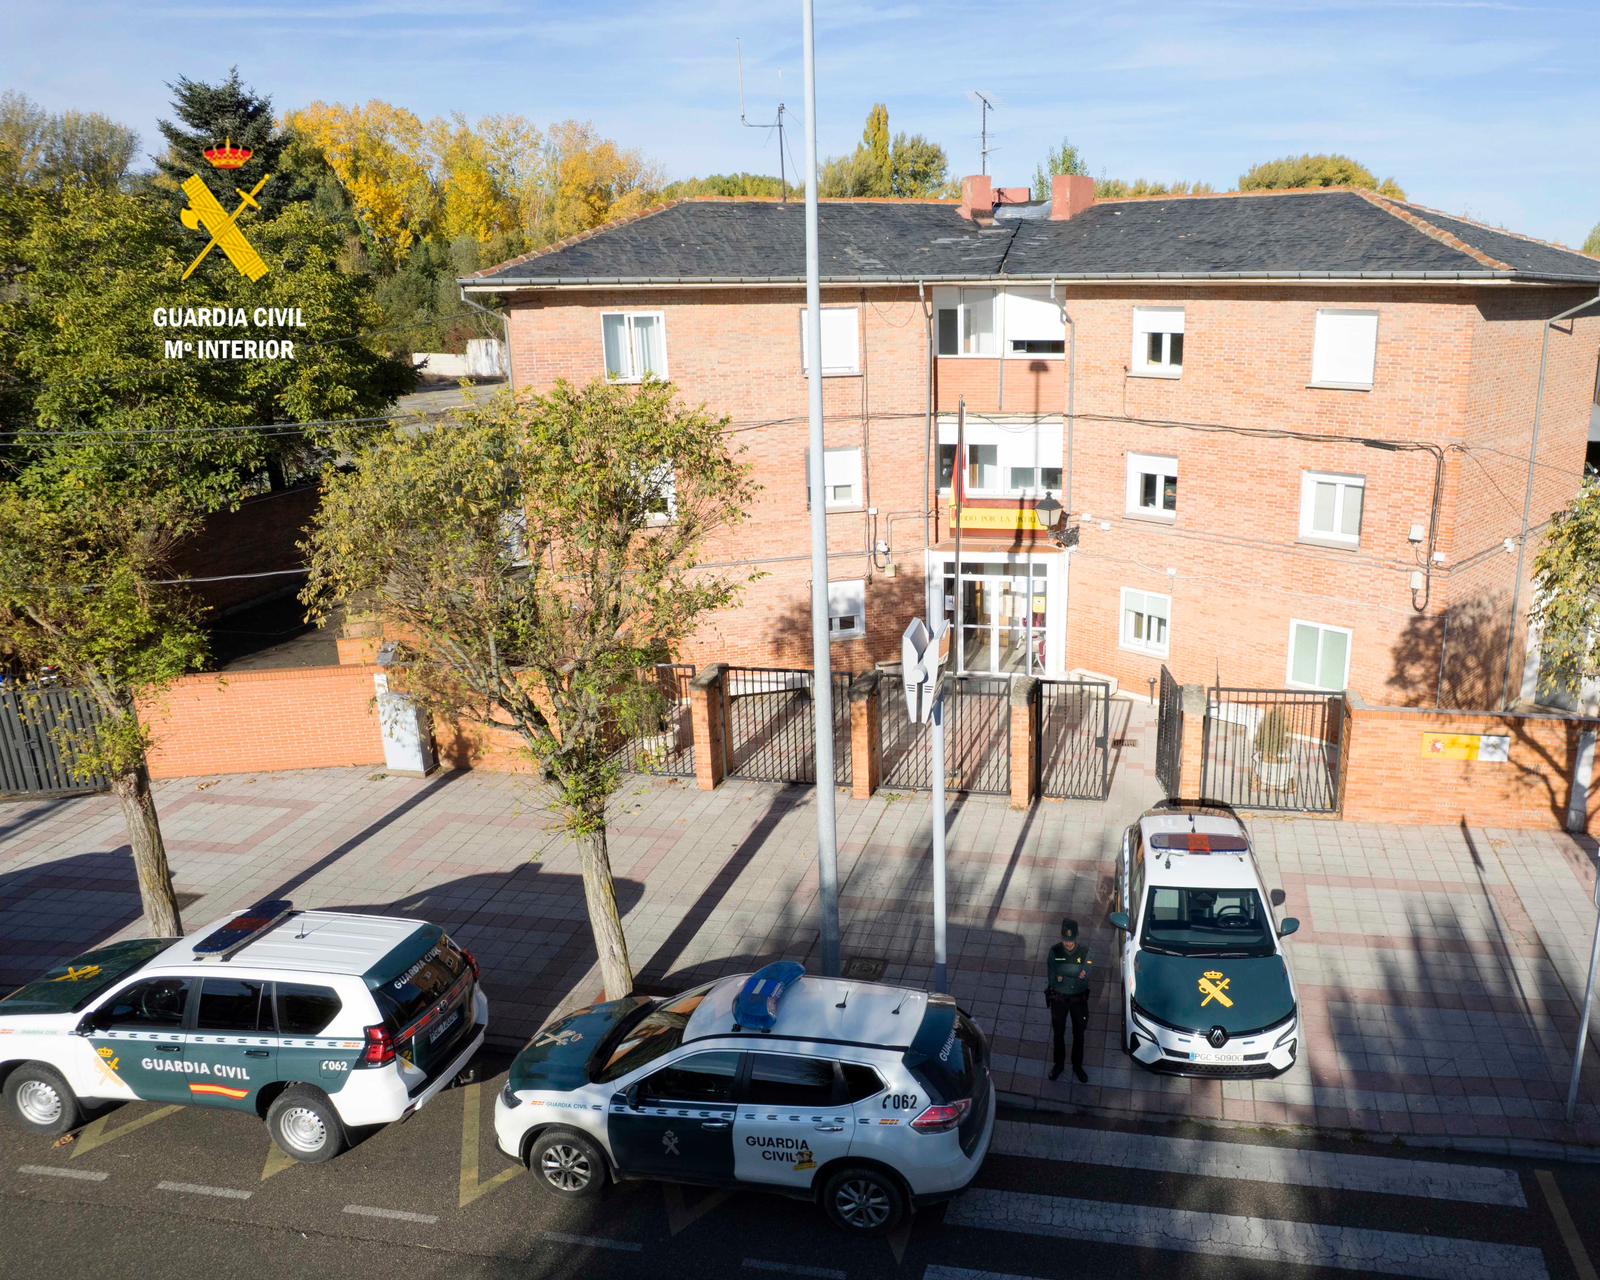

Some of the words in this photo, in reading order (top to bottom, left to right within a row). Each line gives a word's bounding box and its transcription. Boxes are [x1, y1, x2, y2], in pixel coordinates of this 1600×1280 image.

[394, 959, 426, 990] GUARDIA
[141, 1057, 211, 1075] GUARDIA
[213, 1064, 250, 1081] CIVIL
[329, 1060, 348, 1072] 062
[892, 1094, 918, 1110] 062
[745, 1135, 809, 1150] GUARDIA
[761, 1150, 797, 1163] CIVIL
